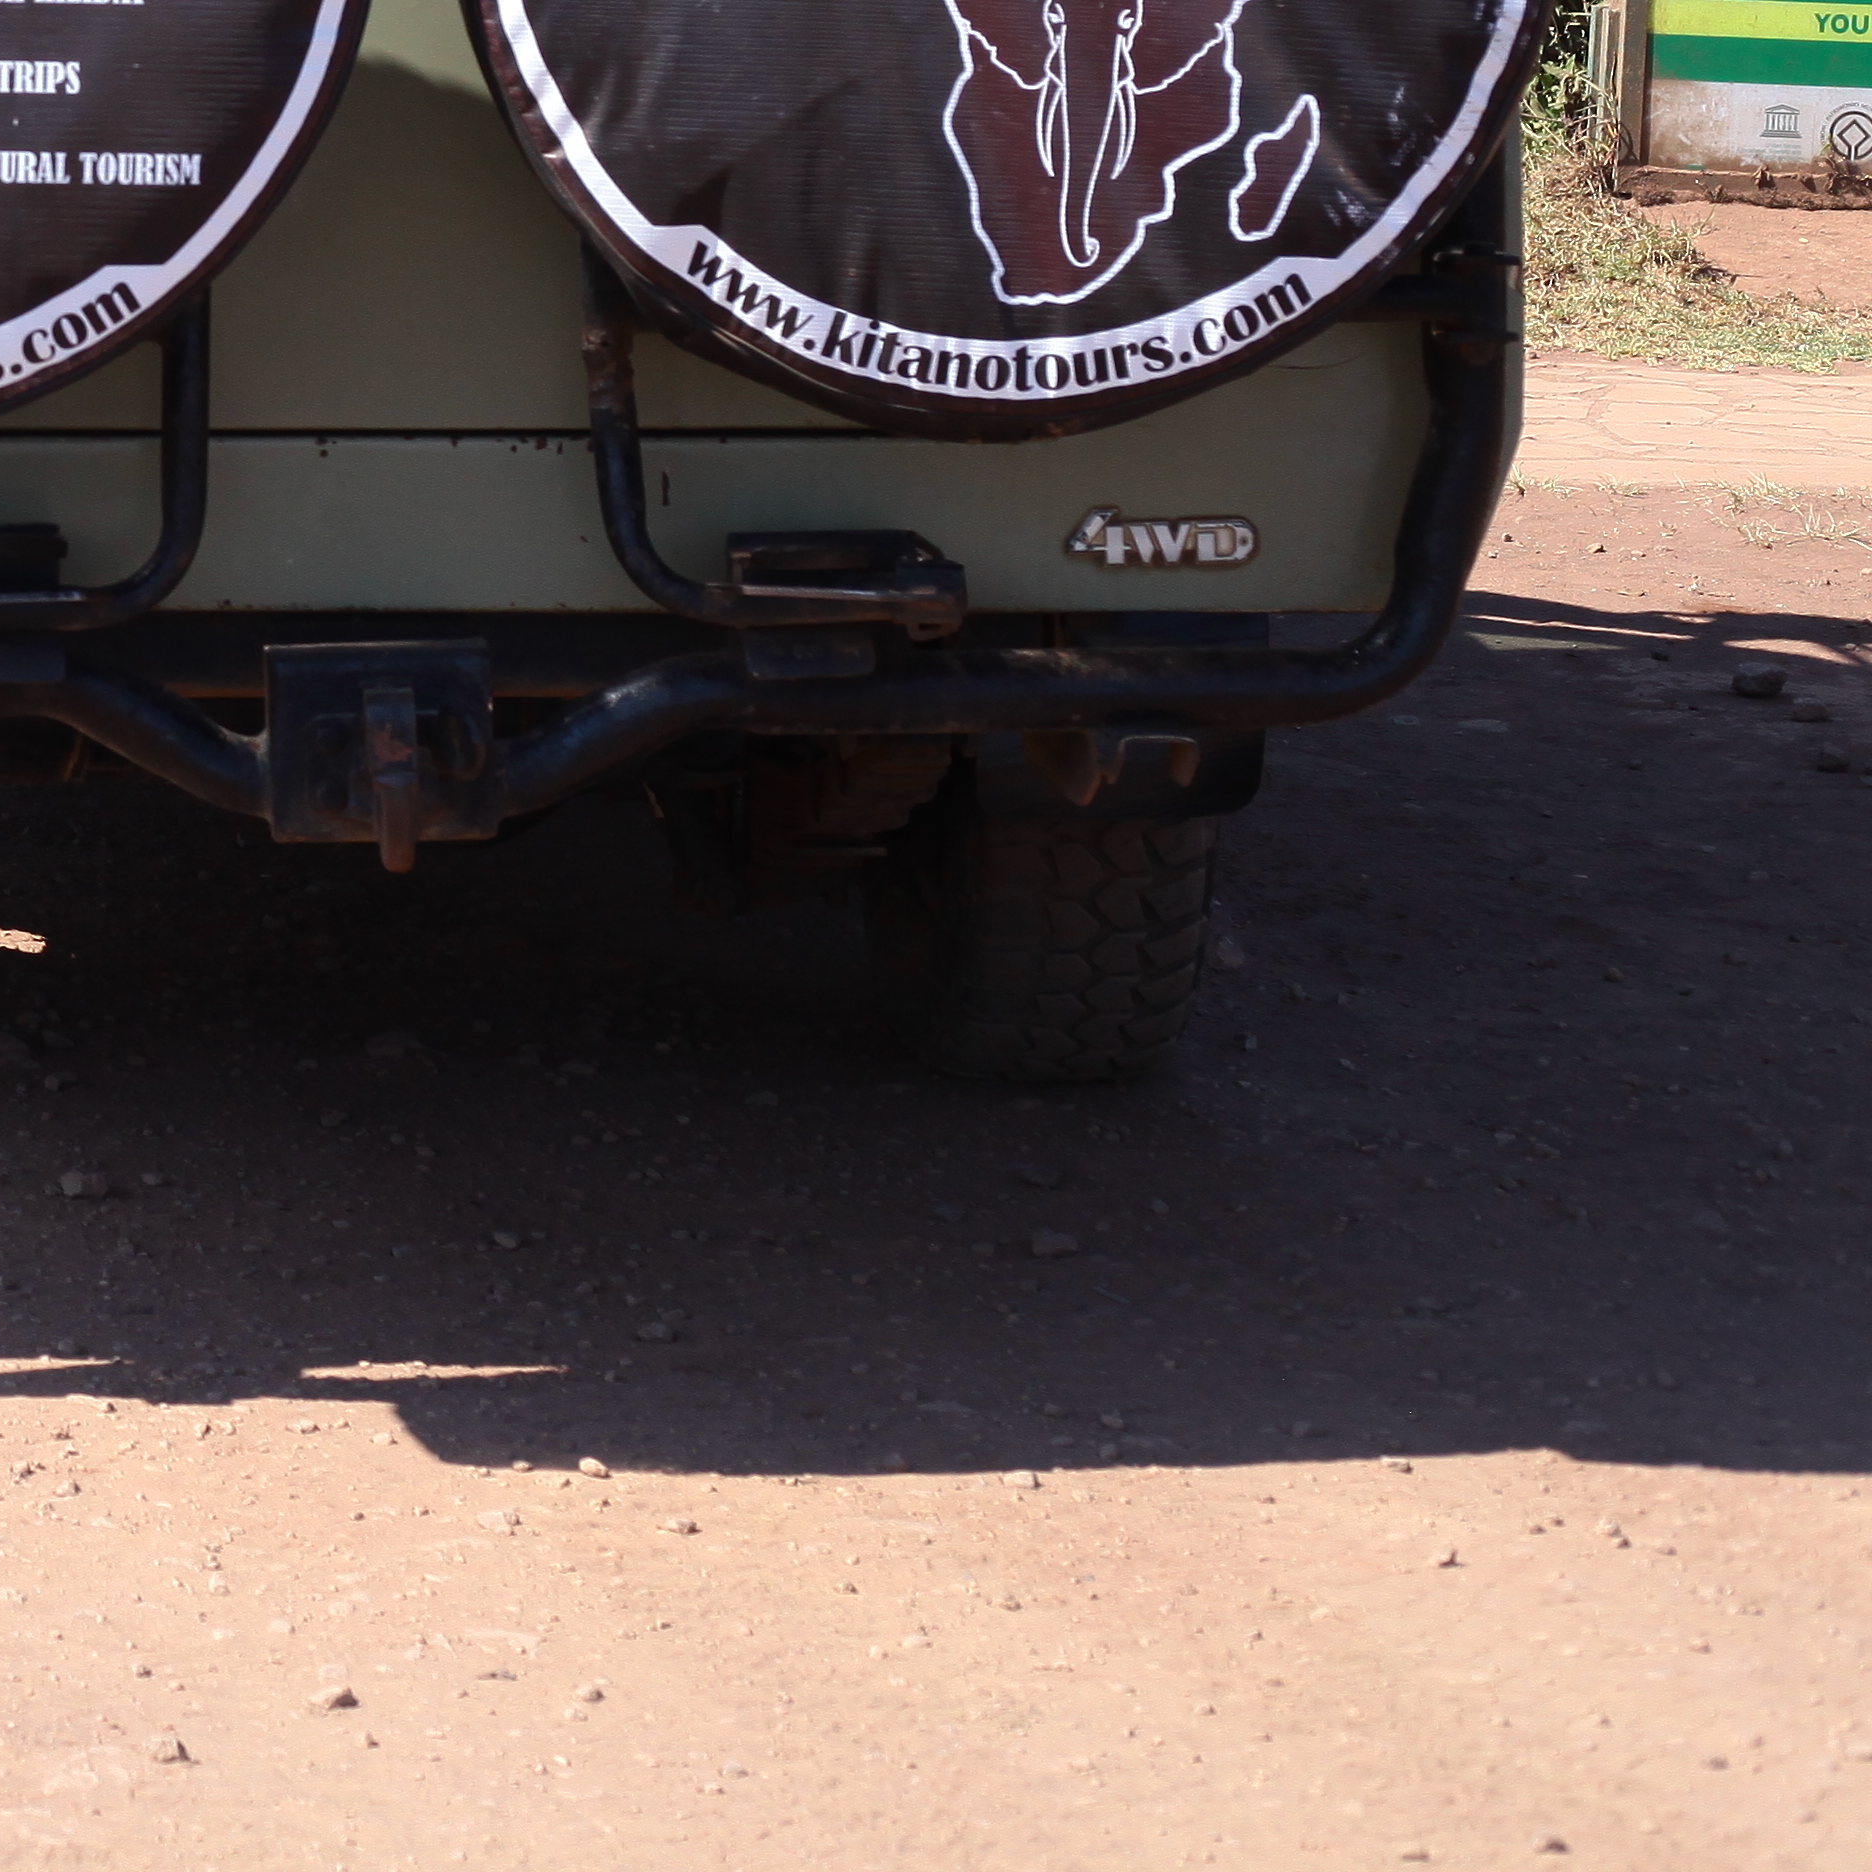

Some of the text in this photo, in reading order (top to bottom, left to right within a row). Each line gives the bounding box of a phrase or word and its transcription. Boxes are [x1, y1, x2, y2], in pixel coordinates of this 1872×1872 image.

[1814, 12, 1870, 35] YOU
[79, 152, 202, 186] TOURISM
[687, 240, 1313, 392] www.kitanotours.com
[1069, 508, 1256, 565] 4WD
